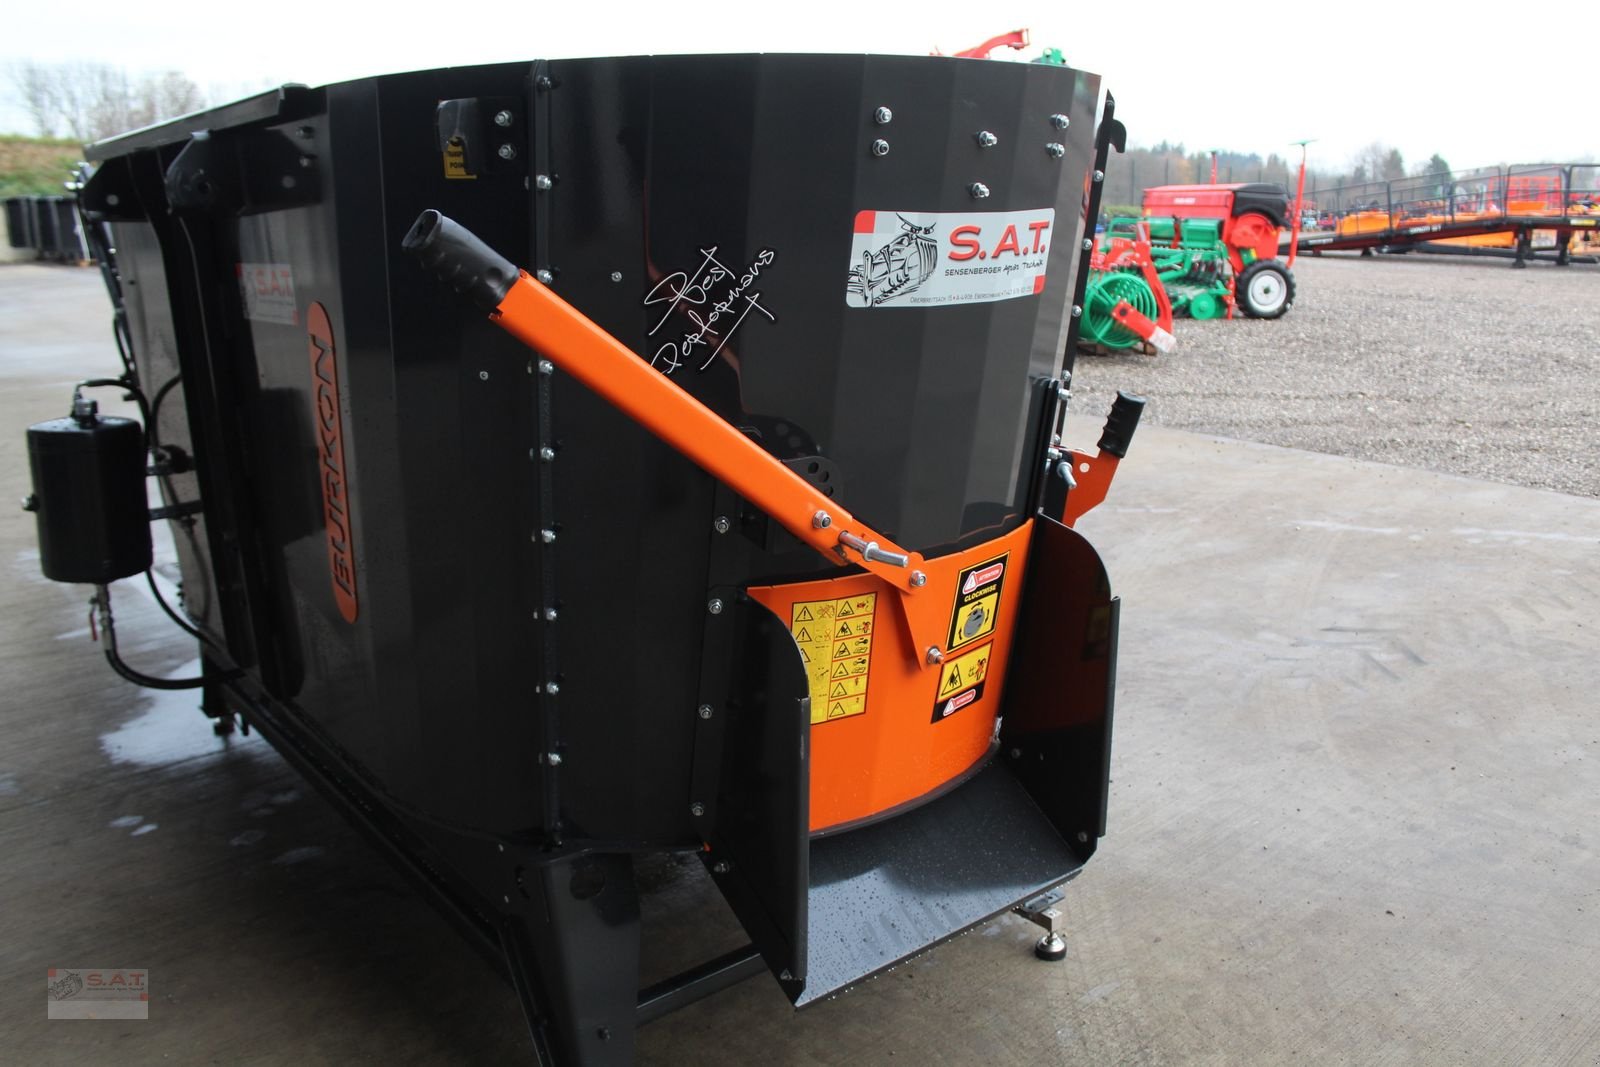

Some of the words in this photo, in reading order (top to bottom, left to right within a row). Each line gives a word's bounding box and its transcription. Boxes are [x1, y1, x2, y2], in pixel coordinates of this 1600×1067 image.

[947, 220, 1050, 261] S.A.T.
[944, 266, 1001, 277] SENSENBERGER
[964, 584, 998, 602] CLOCKWISE
